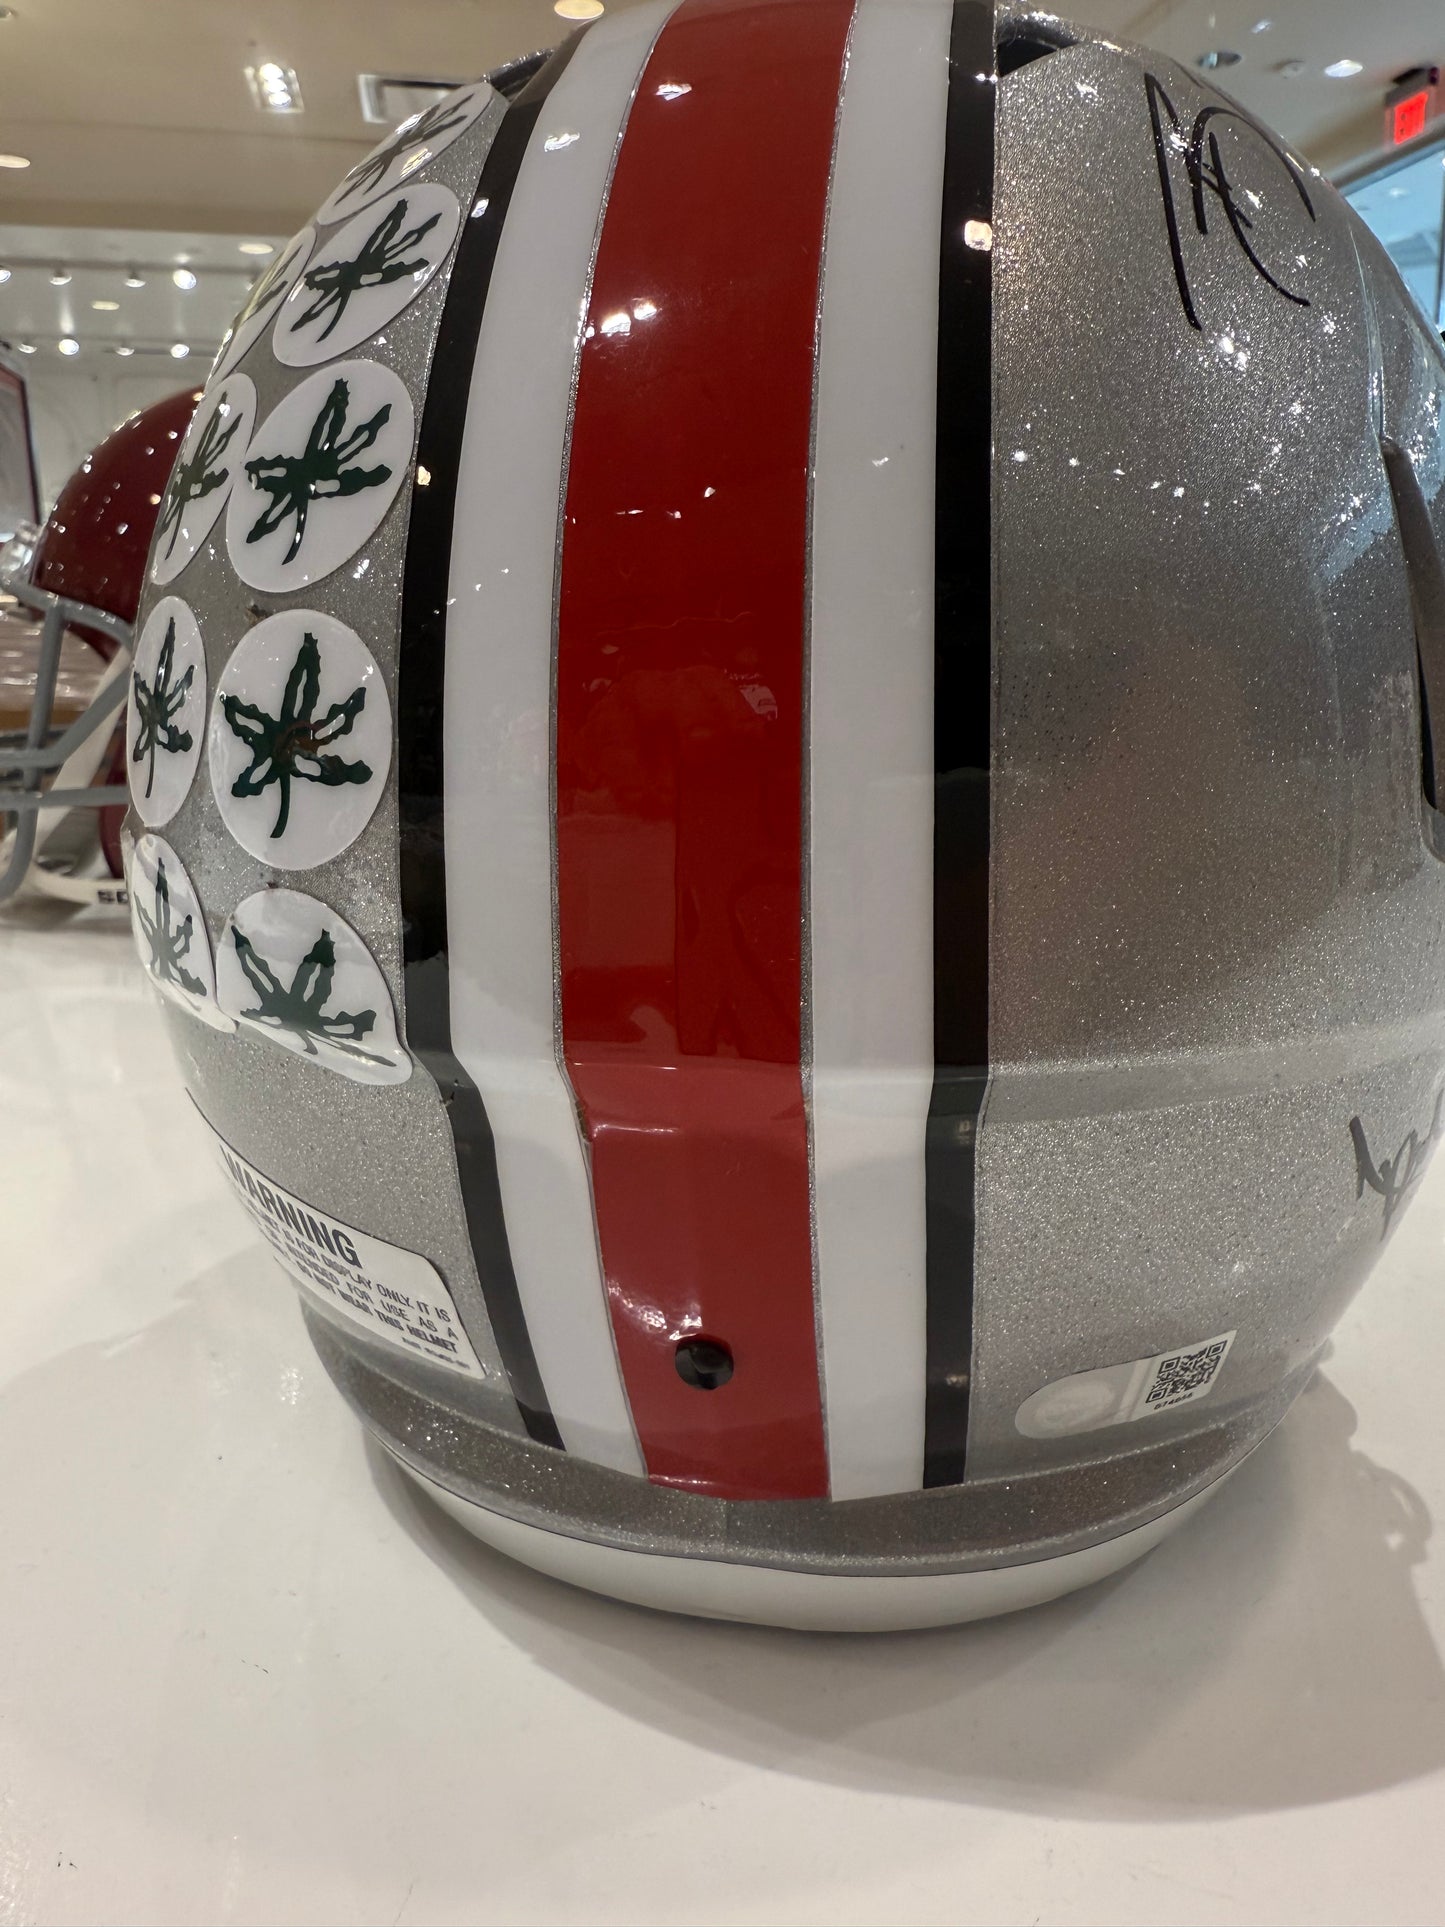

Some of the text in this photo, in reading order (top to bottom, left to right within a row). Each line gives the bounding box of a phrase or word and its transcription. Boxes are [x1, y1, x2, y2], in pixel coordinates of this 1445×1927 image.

[219, 1143, 363, 1269] WARNING
[346, 1281, 374, 1304] FOR
[380, 1299, 410, 1321] USE
[418, 1315, 438, 1332] AS
[447, 1326, 459, 1341] A
[374, 1308, 405, 1331] THIS
[406, 1324, 458, 1354] HELMET
[416, 1300, 430, 1315] IT
[434, 1307, 451, 1323] IS
